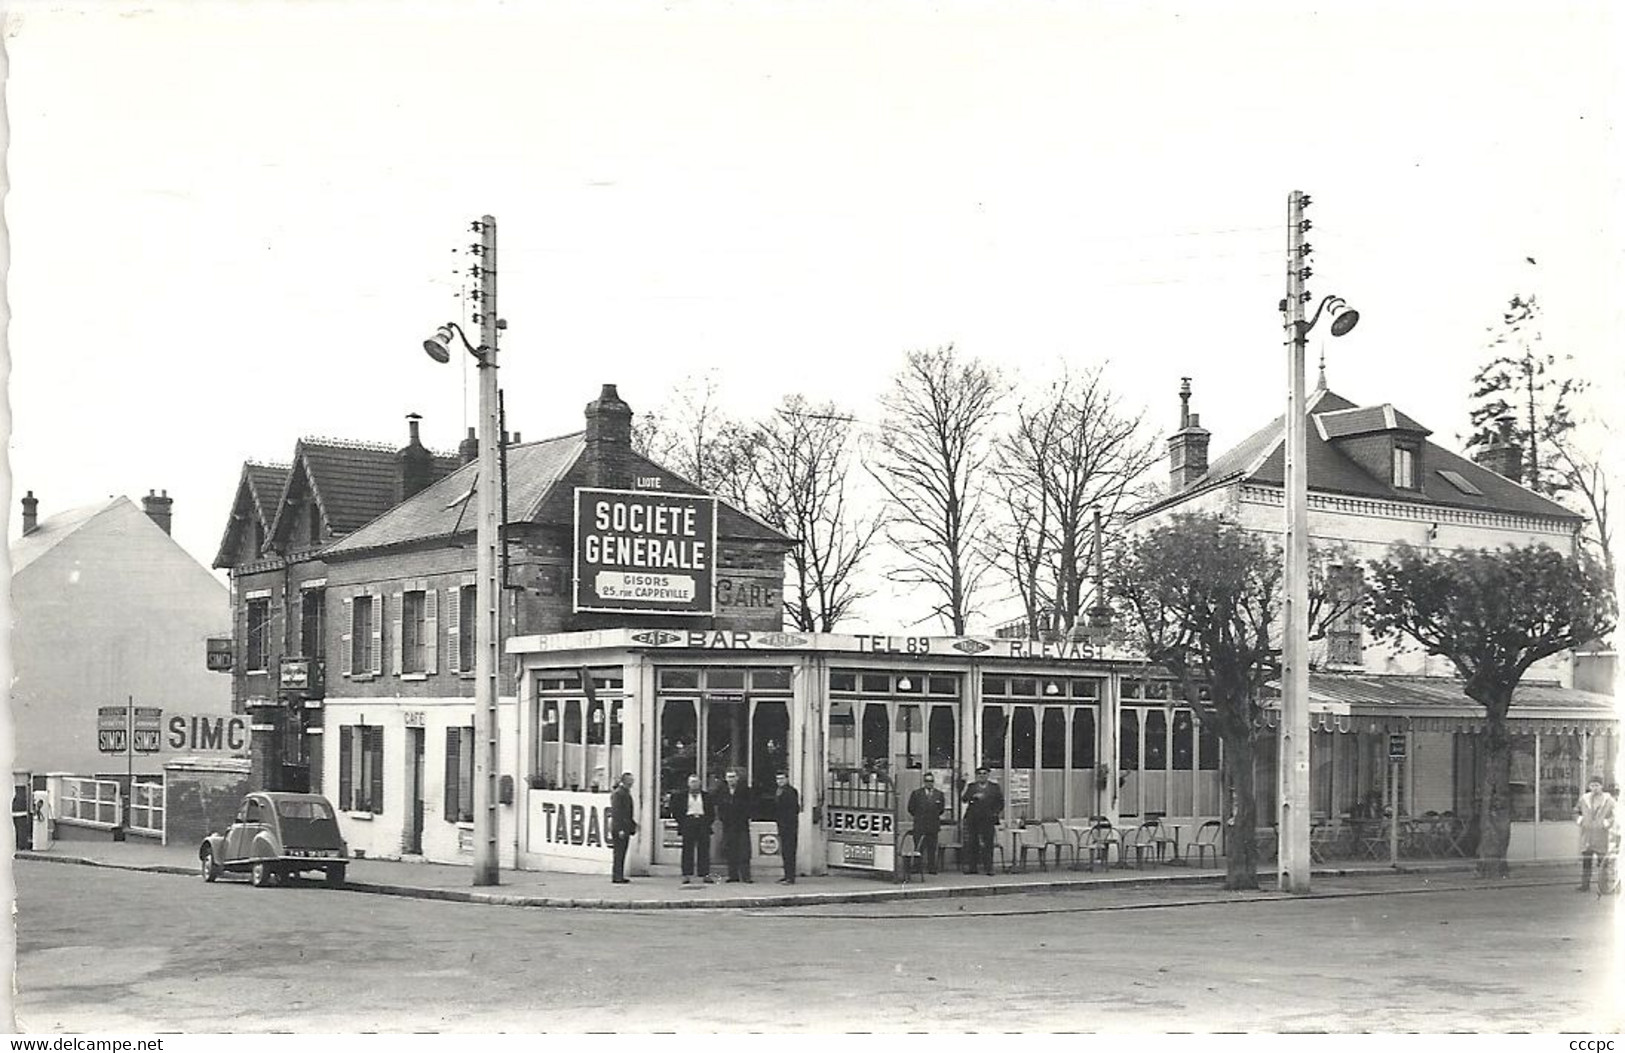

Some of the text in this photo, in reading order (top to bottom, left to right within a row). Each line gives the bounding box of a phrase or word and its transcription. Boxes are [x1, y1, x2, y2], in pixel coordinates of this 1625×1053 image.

[596, 501, 697, 536] SOCIÉTÉ
[586, 532, 706, 570] GÉNÉRALE
[623, 575, 669, 587] GISORS
[635, 588, 689, 599] CAPPEVILLE
[688, 631, 751, 649] BAR
[854, 634, 930, 655] TEL 89
[100, 731, 126, 750] SIMCA
[135, 731, 160, 750] SIMCA
[169, 716, 245, 750] SIMC
